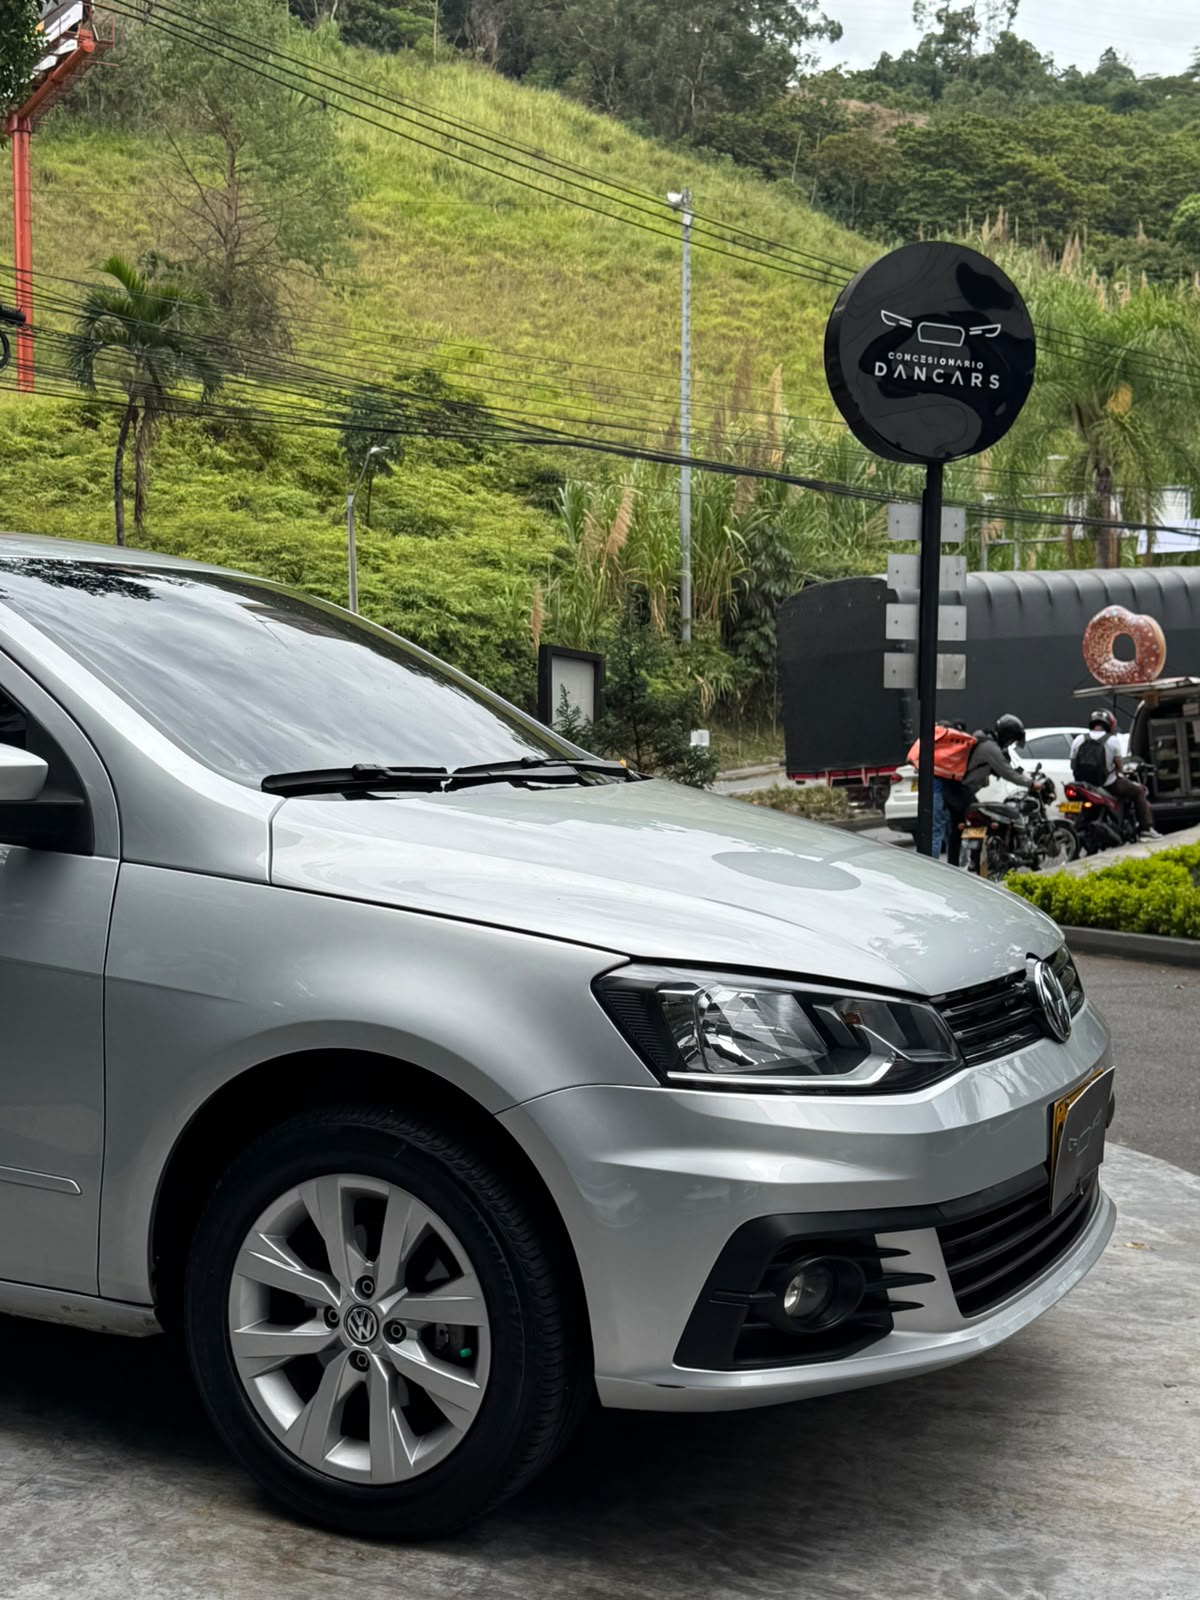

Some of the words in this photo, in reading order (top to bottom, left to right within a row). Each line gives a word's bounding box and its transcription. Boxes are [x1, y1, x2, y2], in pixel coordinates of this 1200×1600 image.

[888, 351, 984, 370] CONCESIONARIO
[874, 361, 1000, 389] DANCARS
[347, 1306, 378, 1343] VW
